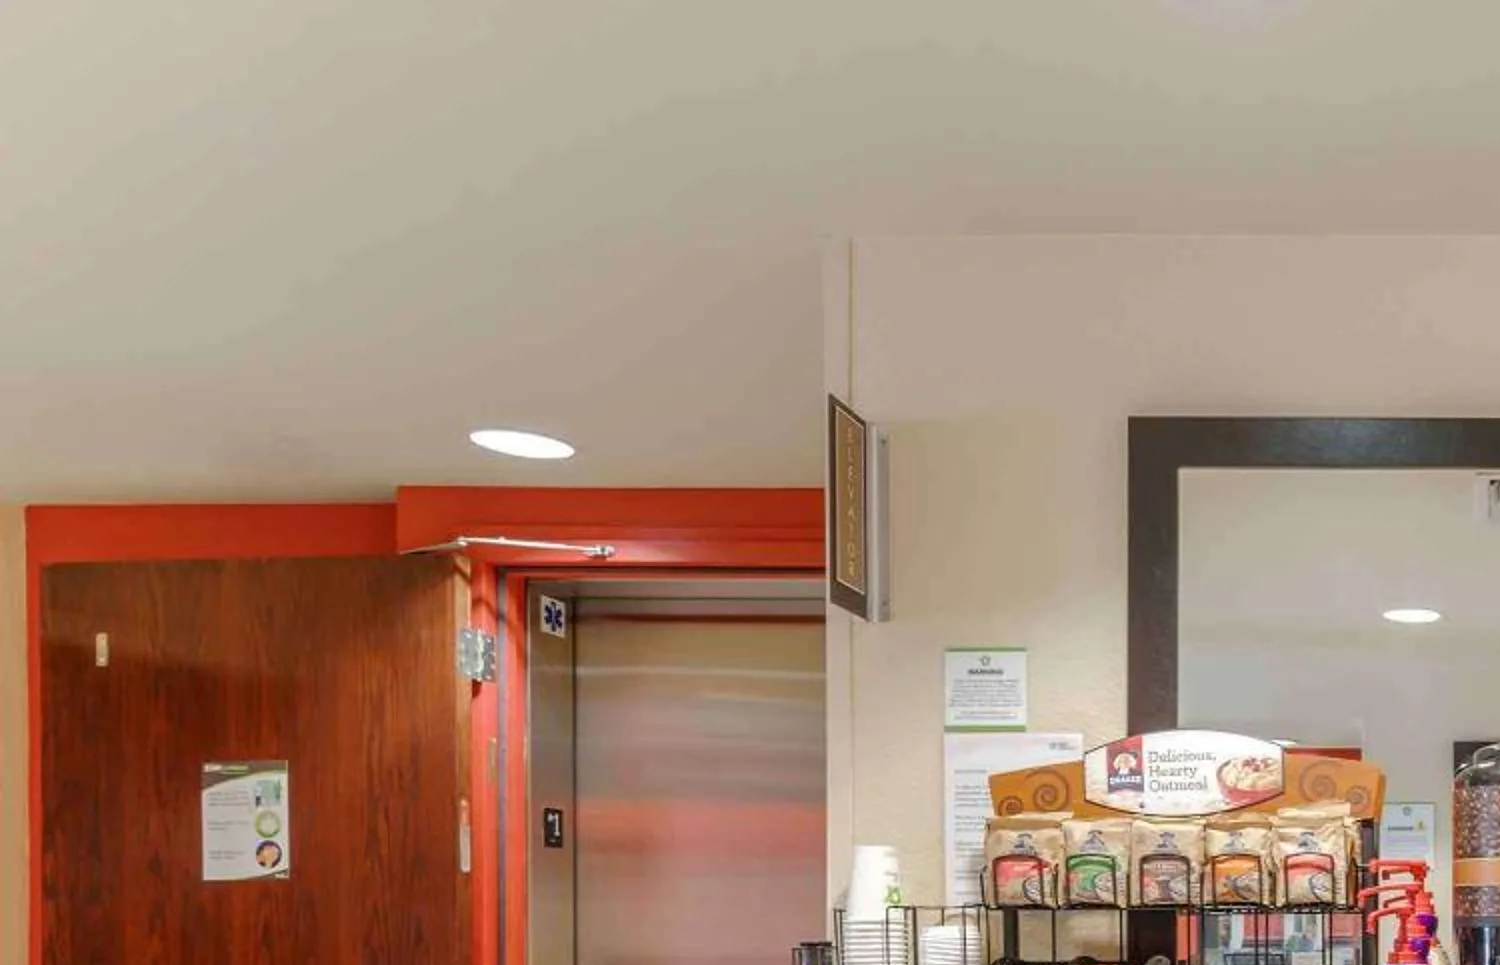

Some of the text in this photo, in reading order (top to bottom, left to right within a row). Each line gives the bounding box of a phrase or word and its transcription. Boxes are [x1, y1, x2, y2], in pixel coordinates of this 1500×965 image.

[1148, 749, 1217, 763] Delicious,
[1148, 765, 1199, 779] Hearty
[1149, 776, 1209, 793] Oatmeal
